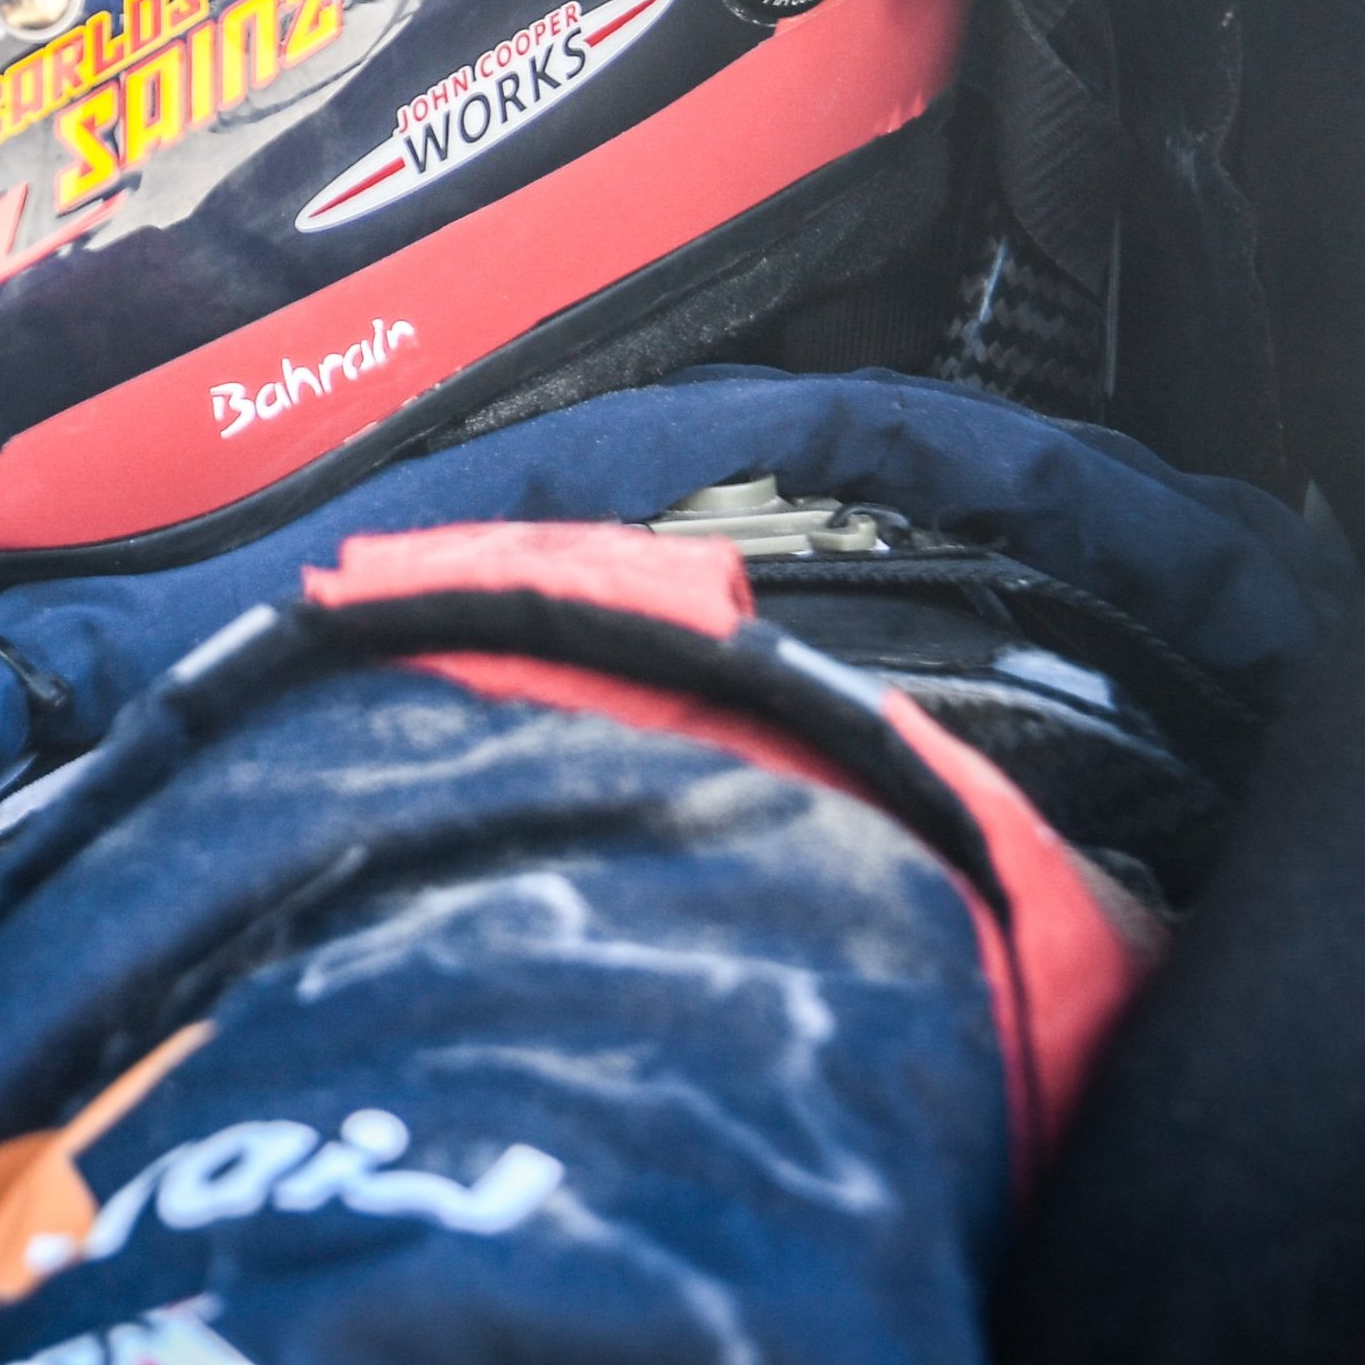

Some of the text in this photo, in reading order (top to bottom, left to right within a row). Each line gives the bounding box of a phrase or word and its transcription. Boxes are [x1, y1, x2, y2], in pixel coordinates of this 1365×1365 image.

[397, 1, 581, 134] JOHN COOPER
[403, 28, 589, 174] WORKS
[209, 318, 417, 440] Bahrain
